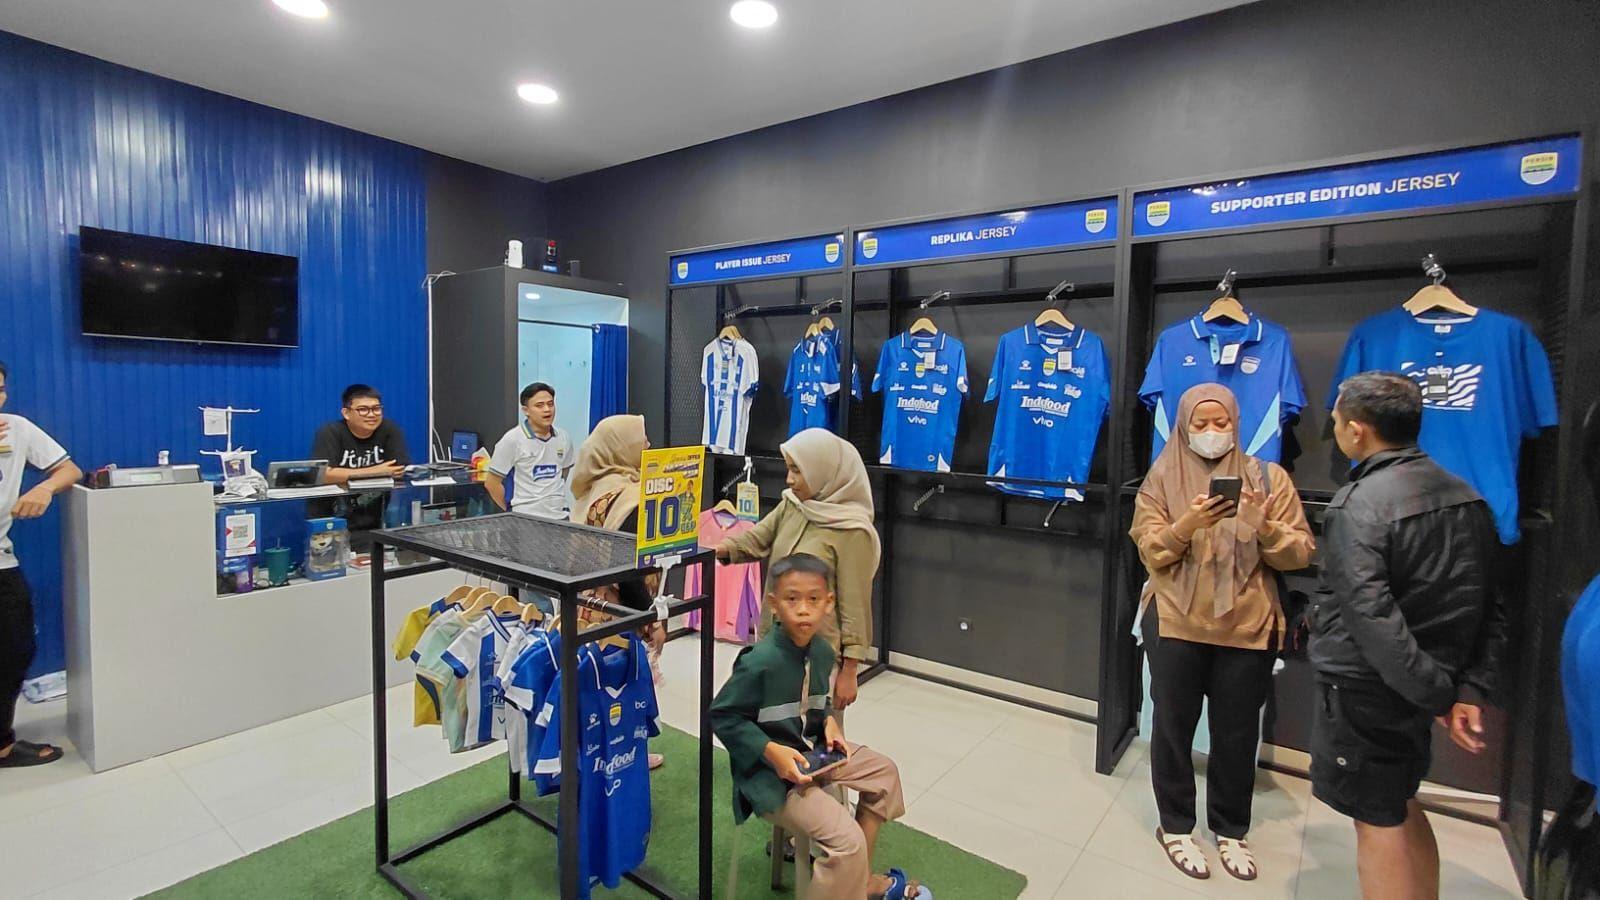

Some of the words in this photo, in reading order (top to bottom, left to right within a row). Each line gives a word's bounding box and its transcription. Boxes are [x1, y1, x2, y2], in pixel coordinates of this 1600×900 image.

[1210, 191, 1307, 214] SUPPORTER
[1309, 181, 1382, 203] EDITION
[1384, 171, 1461, 195] JERSEY
[930, 231, 974, 246] REPLIKA
[975, 225, 1018, 240] JERSEY
[715, 259, 741, 270] PLAYER
[741, 256, 763, 267] ISSUE
[763, 253, 792, 265] JERSEY
[1020, 396, 1072, 413] Indofood
[645, 477, 675, 495] DISC
[644, 496, 681, 541] 10
